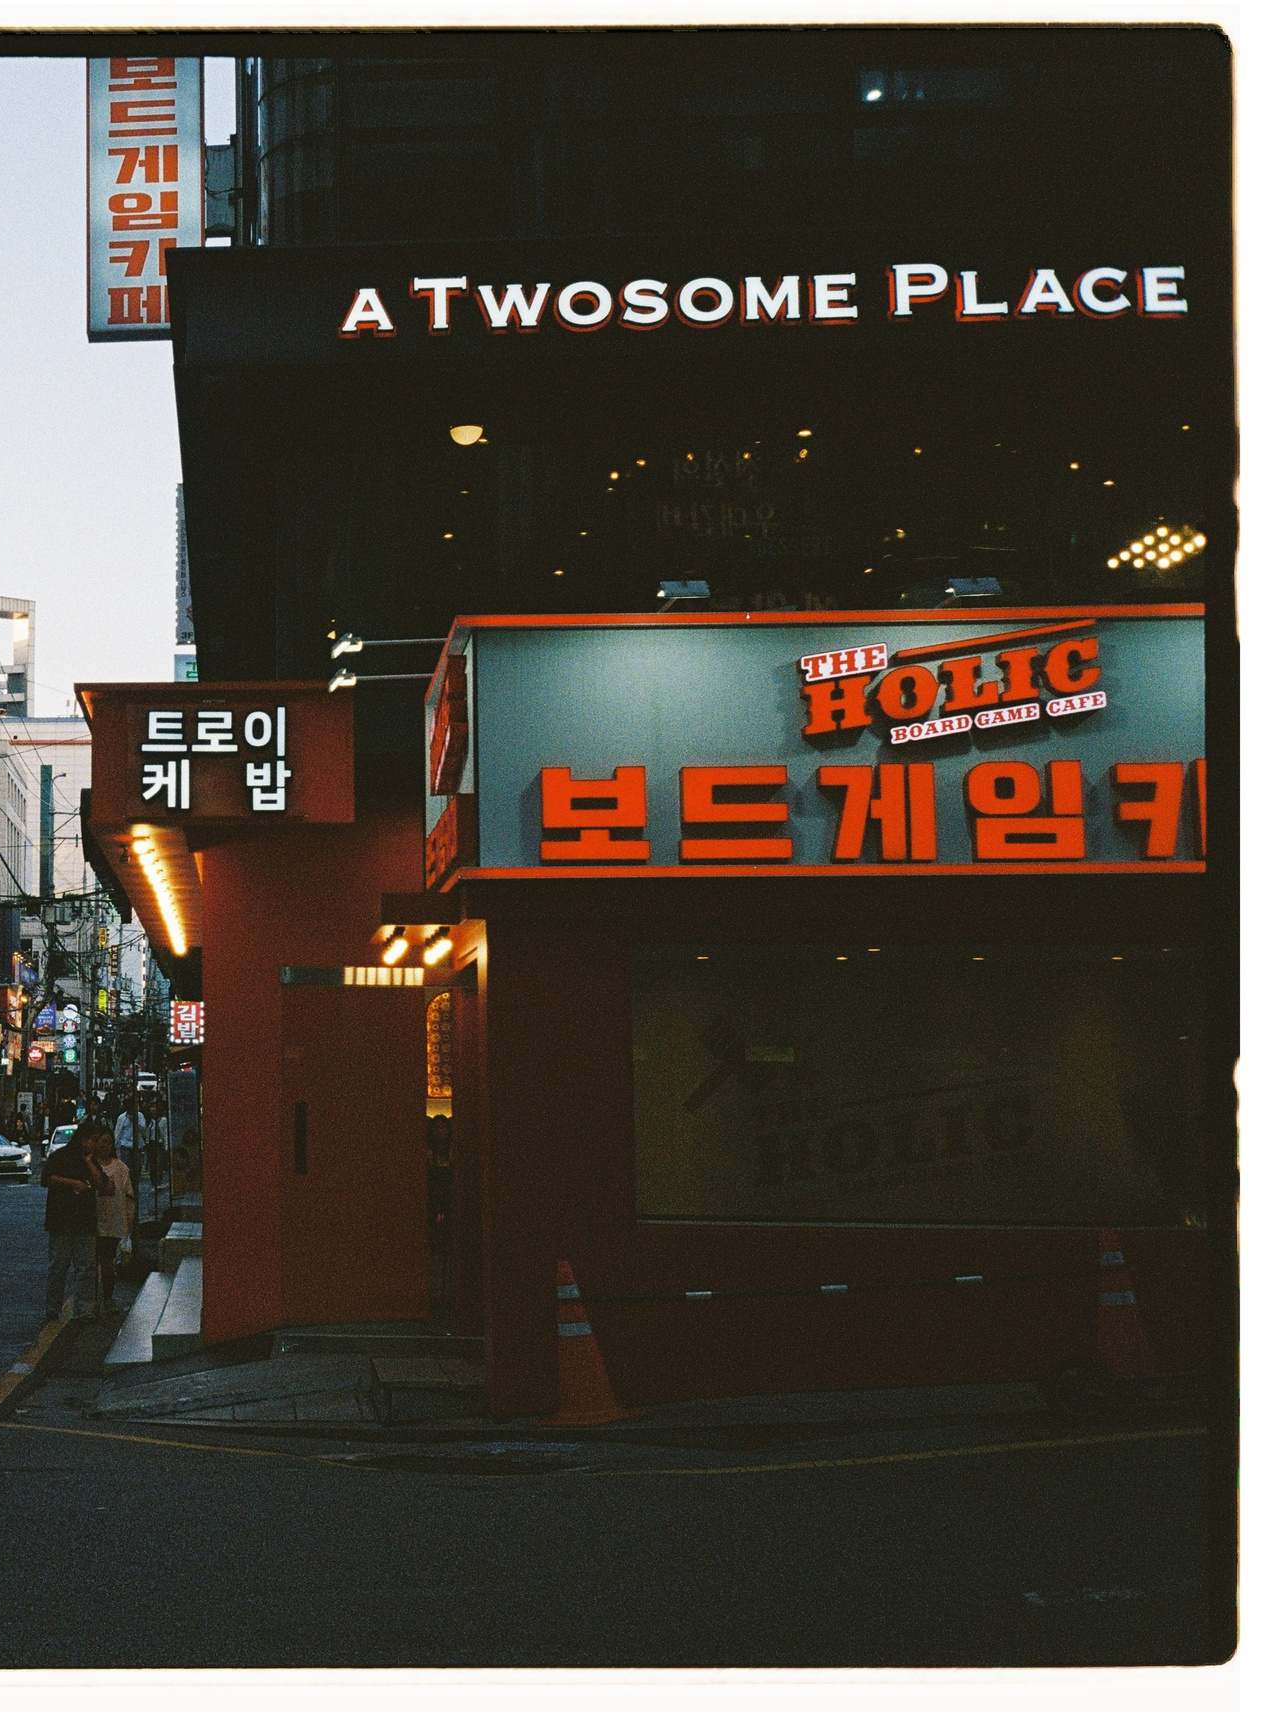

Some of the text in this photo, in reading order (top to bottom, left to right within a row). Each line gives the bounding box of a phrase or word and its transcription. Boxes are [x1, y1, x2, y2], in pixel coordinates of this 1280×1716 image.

[339, 262, 1190, 337] A TWOSOME PLACE
[802, 645, 886, 680] THE
[803, 638, 1101, 735] HOLIC
[141, 707, 286, 757] 트로이
[892, 693, 1105, 742] BOARD GAME CAFE
[142, 759, 292, 811] 케밥
[176, 1005, 199, 1038] 김밥
